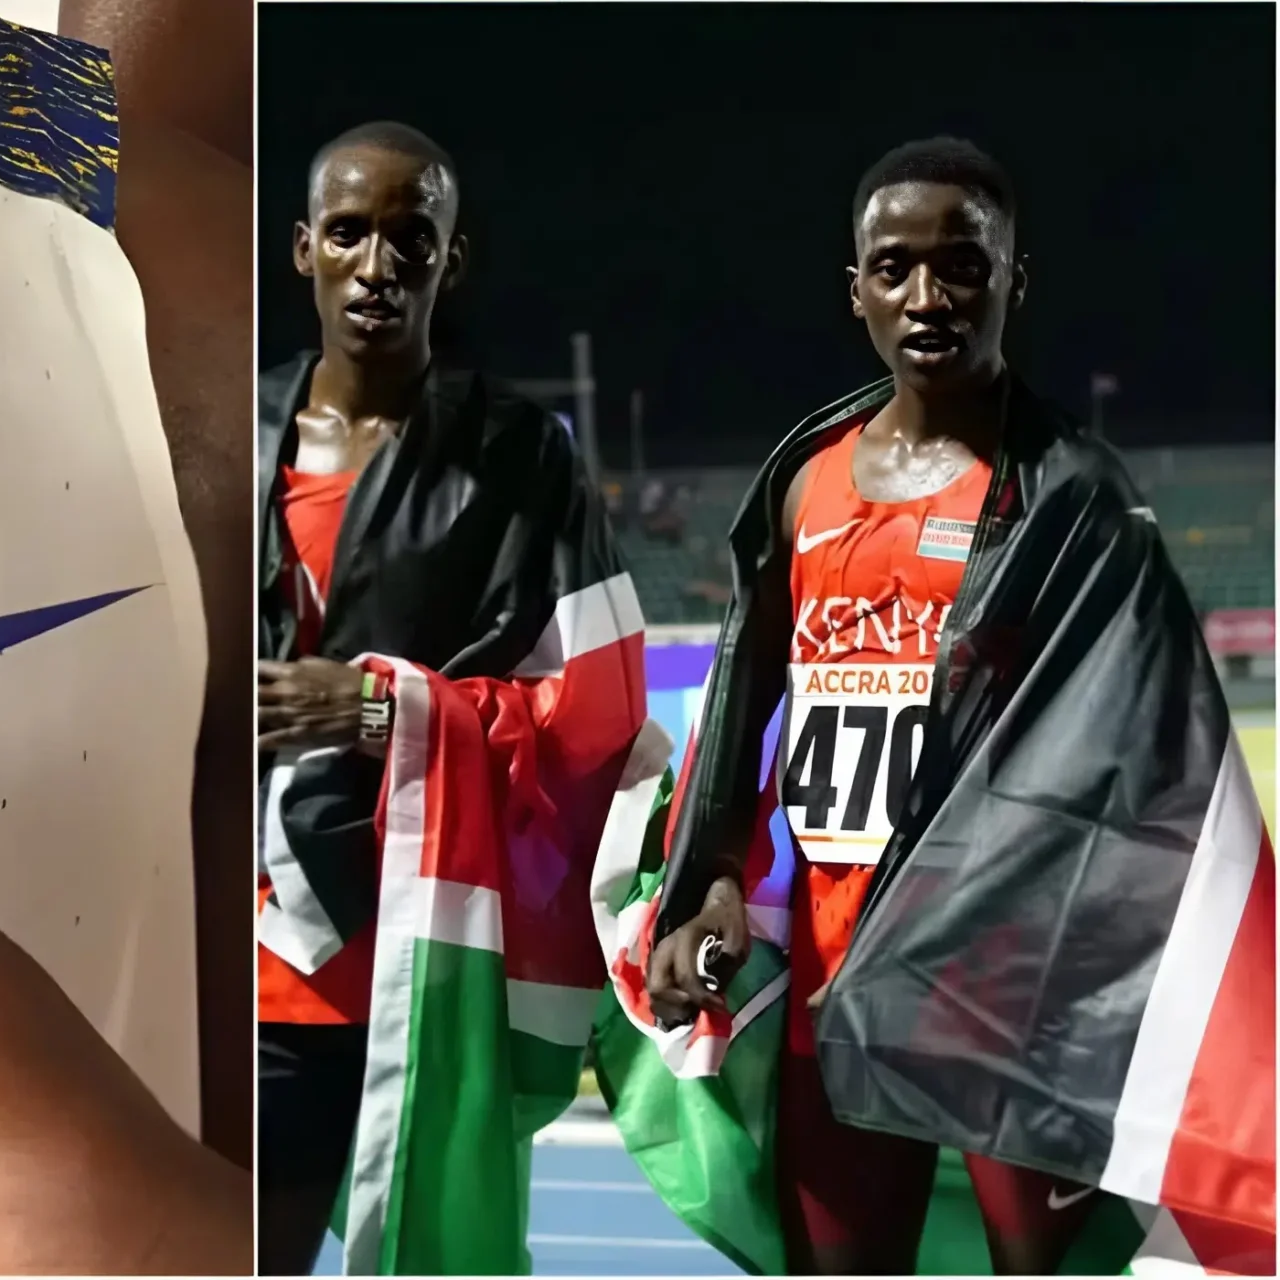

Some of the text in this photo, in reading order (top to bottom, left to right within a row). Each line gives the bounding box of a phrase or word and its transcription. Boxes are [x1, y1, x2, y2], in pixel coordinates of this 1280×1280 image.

[805, 669, 929, 695] ACCRA 20
[782, 705, 933, 831] 470
